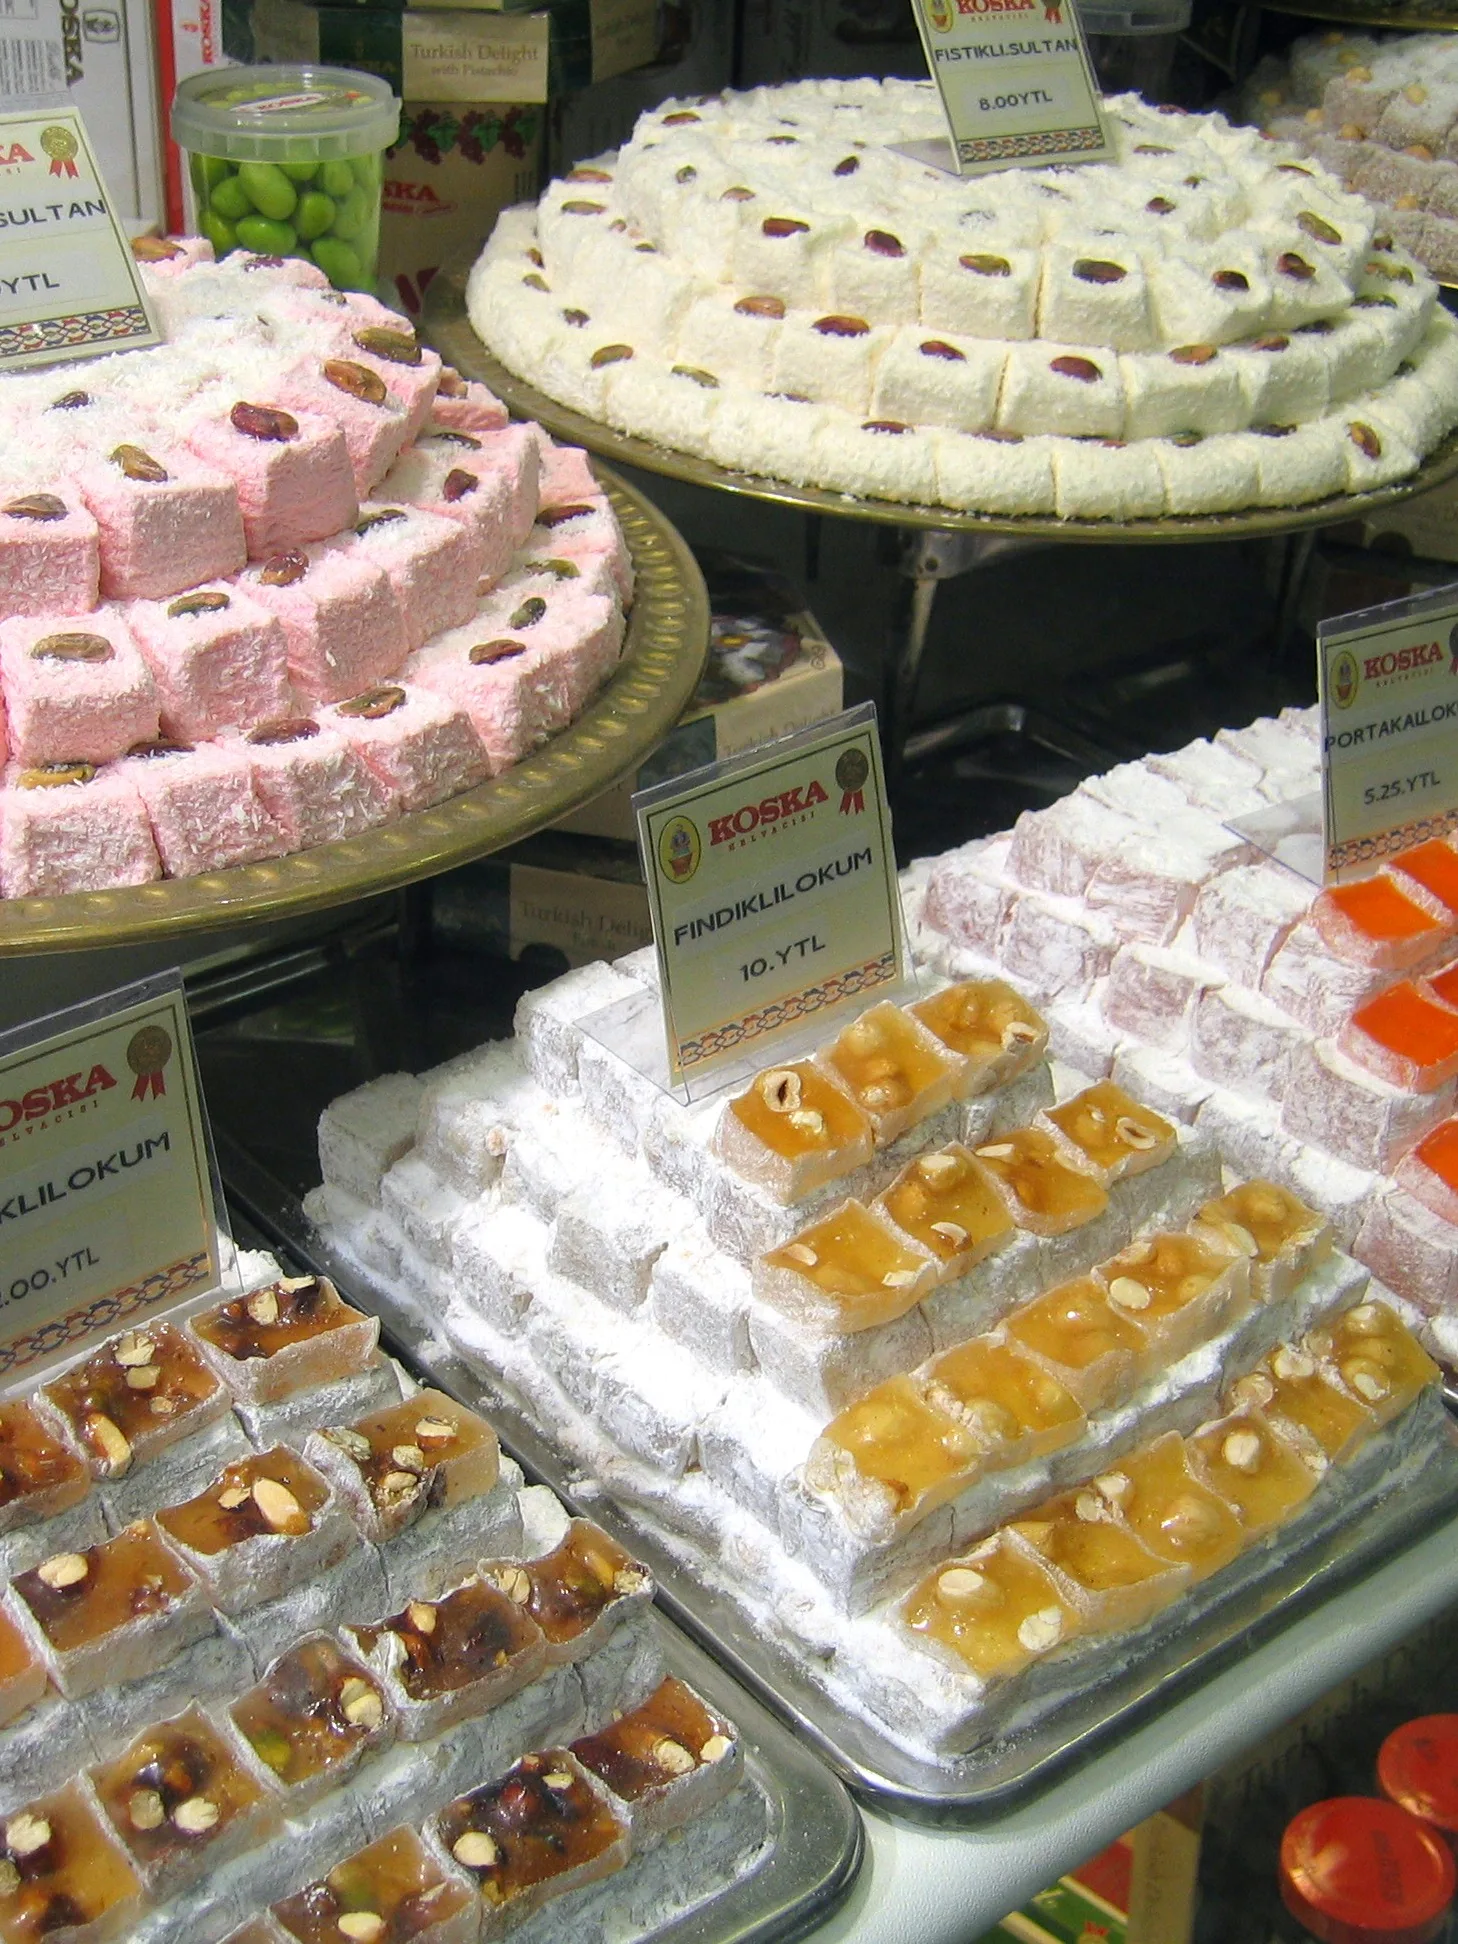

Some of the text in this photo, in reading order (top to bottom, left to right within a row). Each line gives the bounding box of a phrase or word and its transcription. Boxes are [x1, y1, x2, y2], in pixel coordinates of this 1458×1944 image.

[410, 43, 538, 65] Turkish Delight
[1364, 642, 1444, 681] KOSKA
[707, 780, 829, 847] KOSKA
[728, 810, 815, 851] HELVACISI
